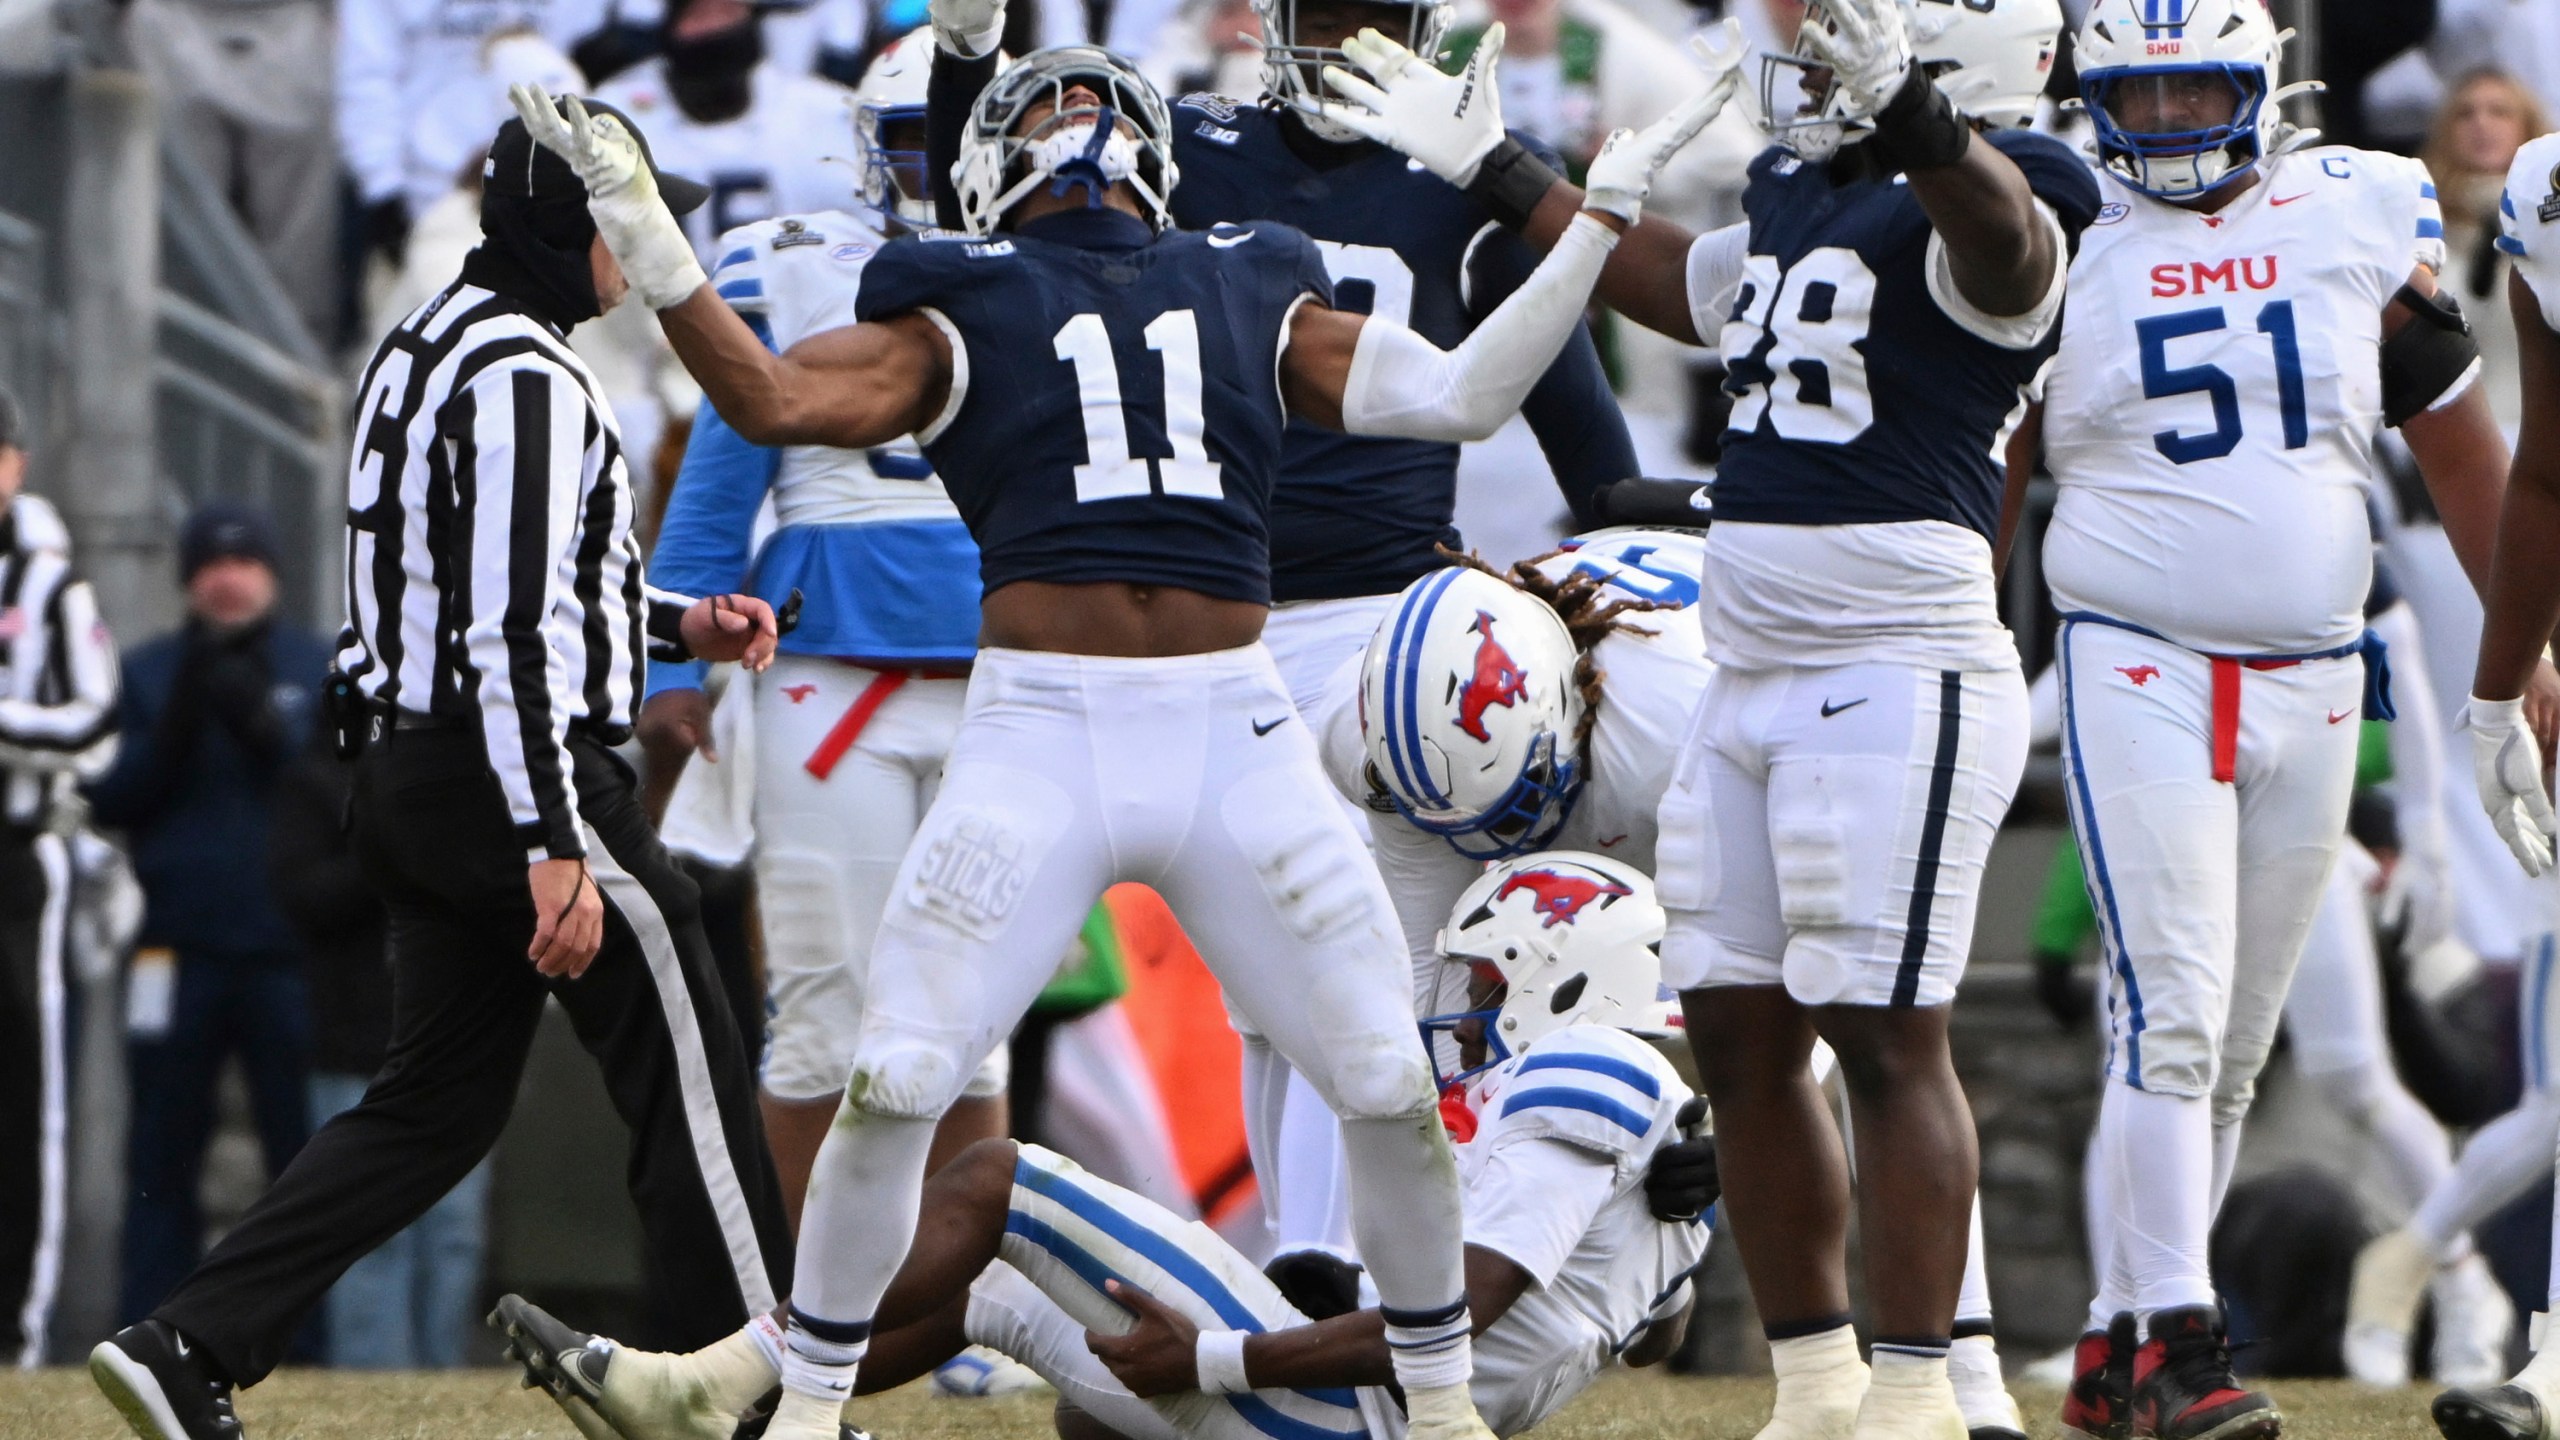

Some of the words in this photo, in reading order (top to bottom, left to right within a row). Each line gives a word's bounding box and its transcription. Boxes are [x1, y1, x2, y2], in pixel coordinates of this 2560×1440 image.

[2146, 43, 2180, 55] SMU
[2320, 157, 2351, 179] C
[2151, 255, 2277, 297] SMU
[1053, 308, 1225, 503] 11
[2135, 299, 2308, 466] 51
[918, 840, 1022, 918] STICKS
